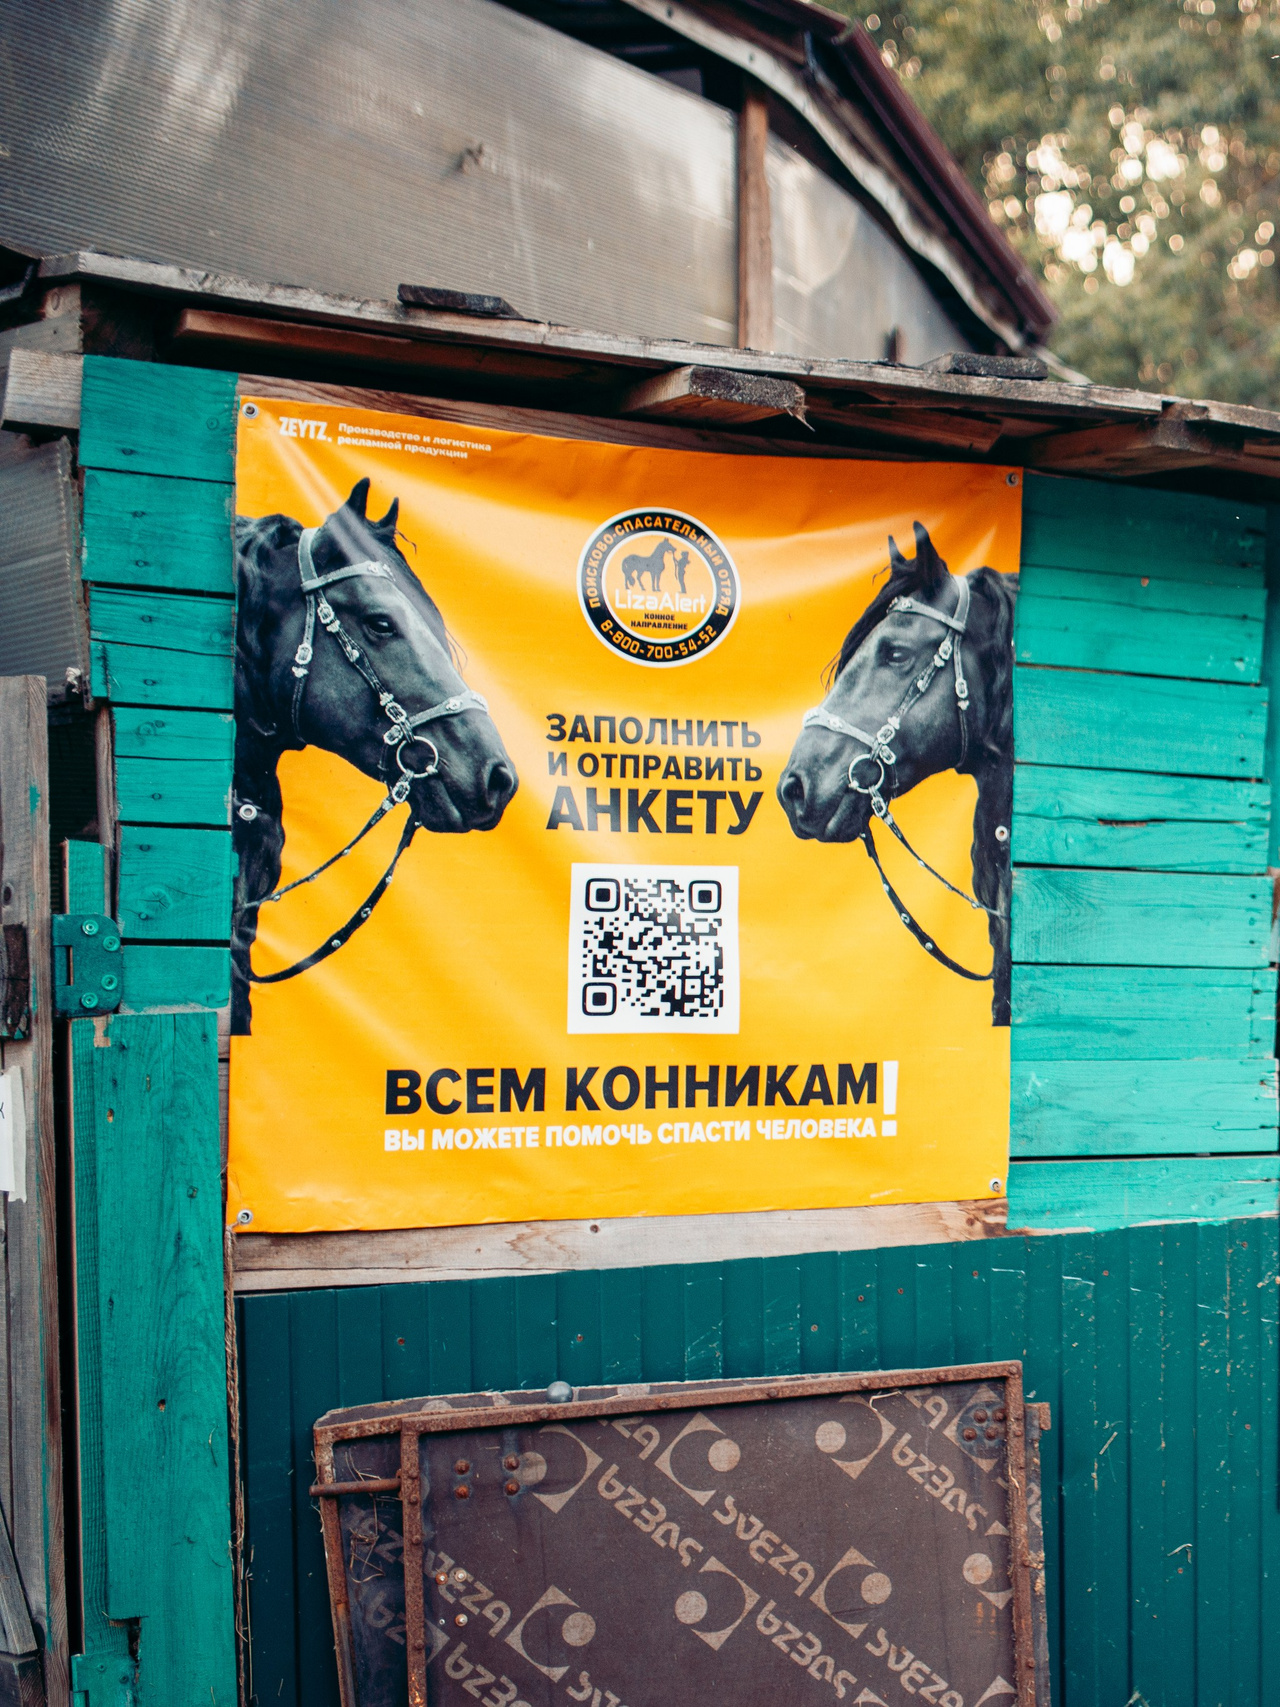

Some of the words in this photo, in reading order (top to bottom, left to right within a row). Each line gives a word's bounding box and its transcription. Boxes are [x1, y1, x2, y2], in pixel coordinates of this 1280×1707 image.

[337, 435, 402, 451] рекламной
[404, 443, 468, 459] продукции
[338, 422, 421, 442] Производство
[422, 434, 431, 443] и
[433, 437, 492, 452] логистика
[615, 588, 707, 614] LizaAlert
[715, 570, 732, 617] ОТРЯД
[630, 621, 688, 630] НАПРАВЛЕНИЕ
[644, 613, 675, 621] КОННОЕ
[600, 619, 717, 660] 8-800-700-54-52
[546, 713, 762, 748] ЗАПОЛНИТЬ
[548, 751, 568, 777] И
[577, 752, 763, 782] ОТПРАВИТЬ
[545, 785, 764, 835] АНКЕТУ
[385, 1067, 546, 1115] ВСЕМ
[384, 1129, 425, 1152] ВЫ
[432, 1126, 540, 1150] МОЖЕТЕ
[546, 1123, 652, 1148] ПОМОЧЬ
[658, 1120, 751, 1144] СПАСТИ
[756, 1117, 877, 1141] ЧЕЛОВЕКА
